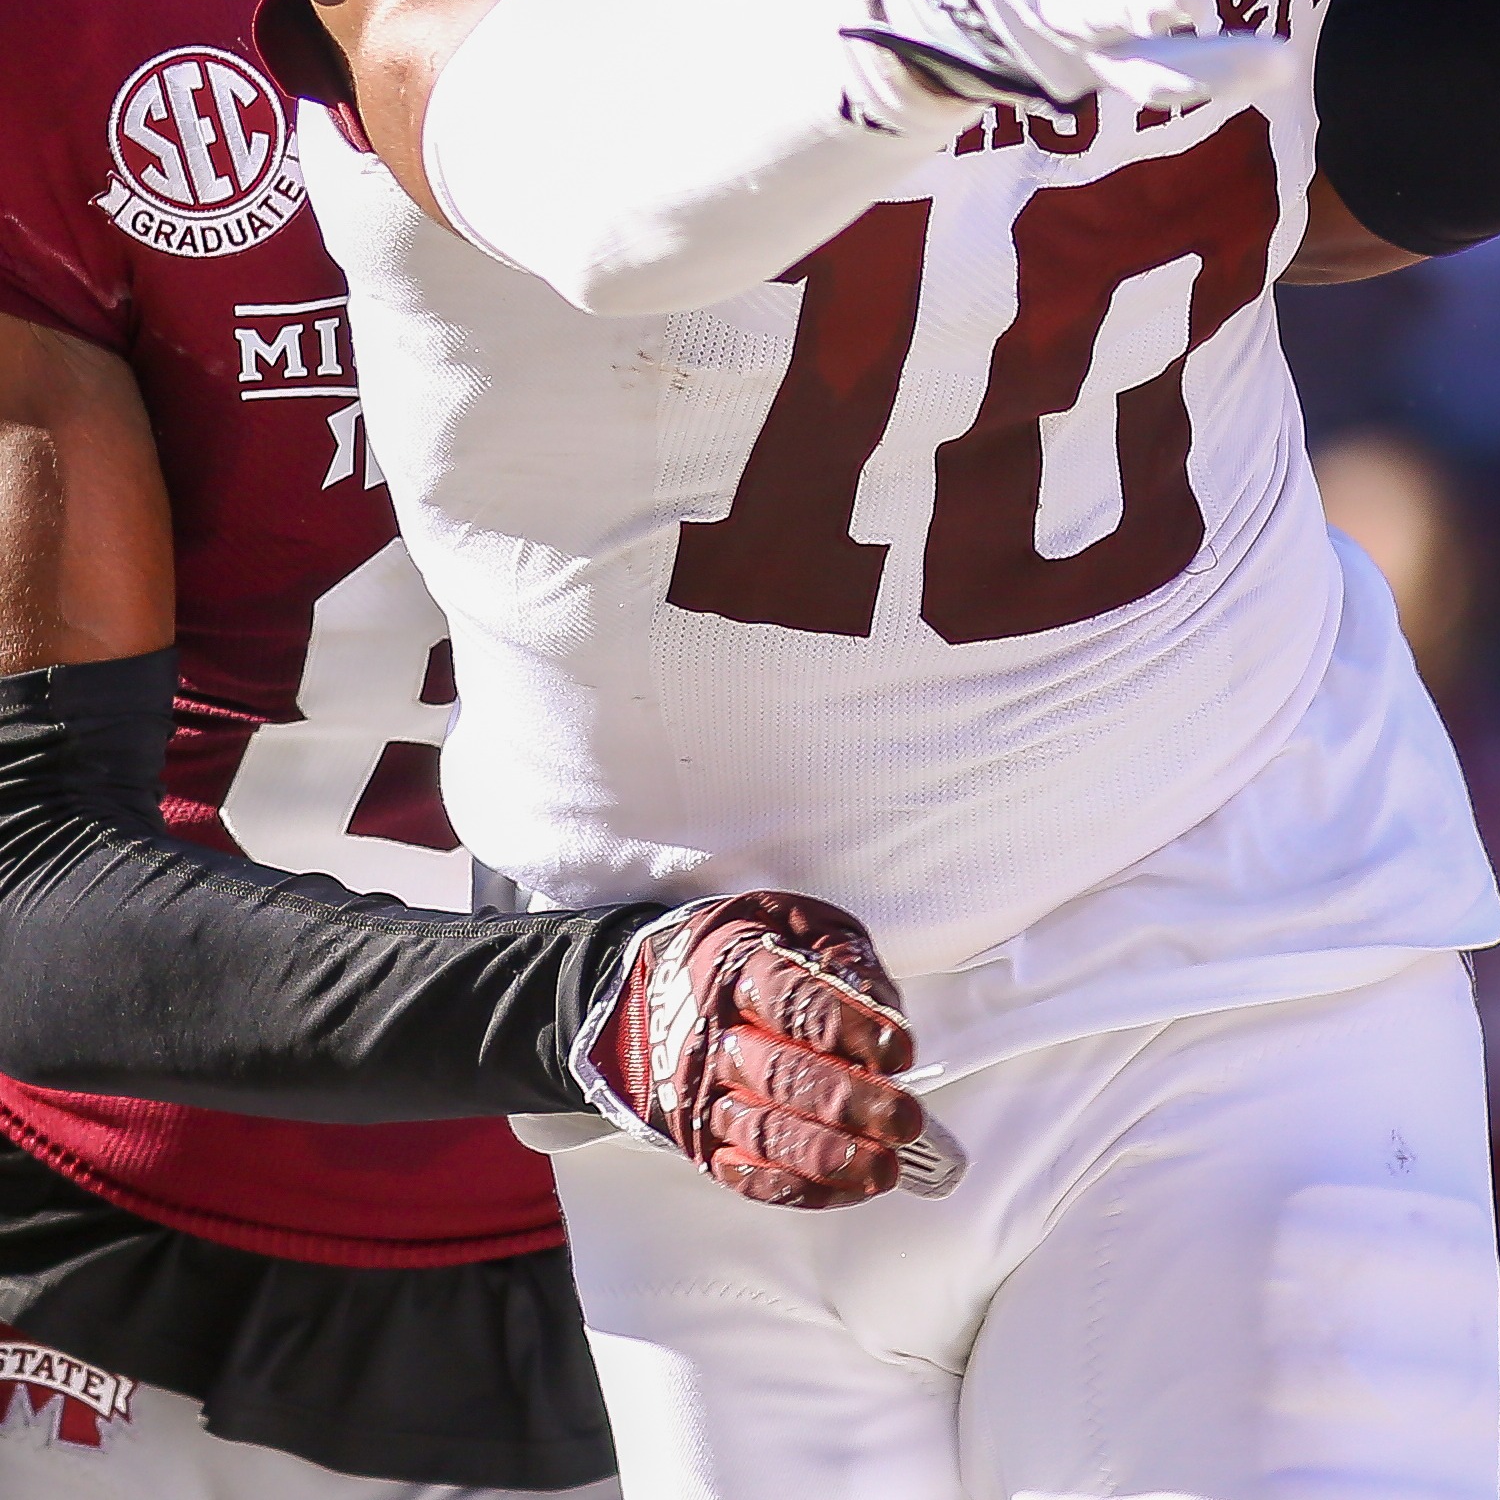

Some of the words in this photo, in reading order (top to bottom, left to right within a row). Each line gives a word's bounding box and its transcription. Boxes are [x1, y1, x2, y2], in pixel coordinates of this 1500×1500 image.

[123, 60, 270, 206] SEC
[130, 174, 303, 255] GRADUATE
[234, 318, 356, 382] MI
[666, 104, 1281, 645] 10
